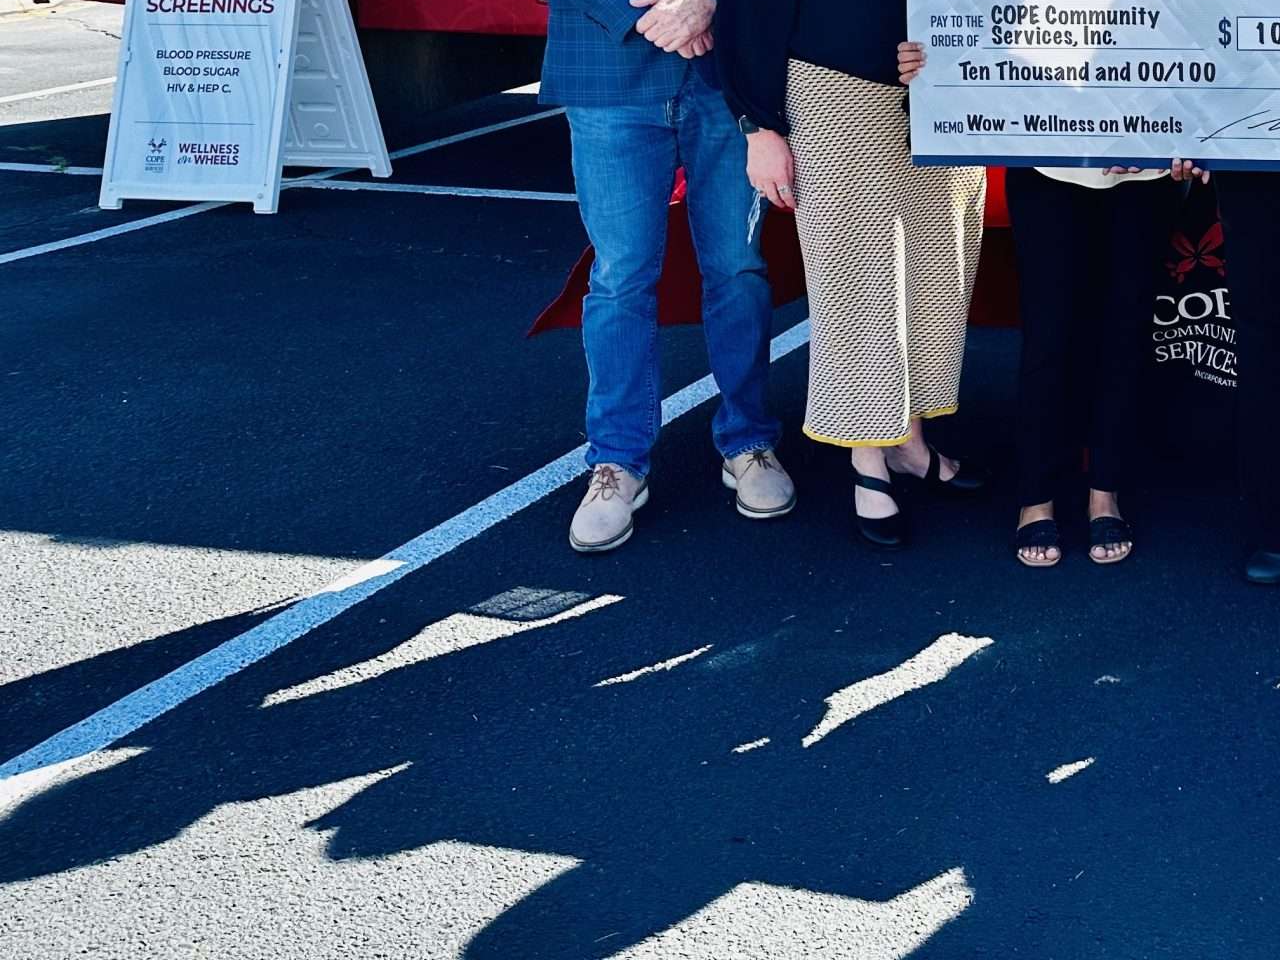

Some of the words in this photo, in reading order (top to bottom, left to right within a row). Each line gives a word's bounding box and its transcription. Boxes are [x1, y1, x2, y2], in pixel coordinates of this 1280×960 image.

[930, 15, 947, 29] PAY
[949, 15, 963, 29] TO
[964, 15, 984, 29] THE
[991, 5, 1039, 25] COPE
[1045, 5, 1160, 29] Community
[931, 34, 964, 48] ORDER
[967, 34, 980, 48] OF
[991, 26, 1078, 47] Services,
[1083, 26, 1117, 46] Inc.
[1218, 17, 1232, 49] $
[156, 50, 194, 60] BLOOD
[196, 50, 252, 60] PRESSURE
[163, 66, 201, 76] BLOOD
[203, 67, 240, 77] SUGAR
[959, 62, 992, 82] Ten
[996, 62, 1090, 82] Thousand
[1095, 62, 1131, 82] and
[1137, 61, 1216, 83] 00/100
[167, 83, 186, 93] HIV
[187, 84, 195, 93] &
[197, 83, 219, 93] HEP
[933, 121, 964, 135] MEMO
[966, 114, 1004, 132] Wow
[1023, 114, 1096, 133] Wellness
[1099, 120, 1118, 133] on
[1123, 115, 1183, 134] Wheels
[178, 143, 240, 154] WELLNESS
[194, 154, 239, 165] WHEELS
[1153, 288, 1232, 326] COP
[1152, 323, 1237, 345] COMMUNI
